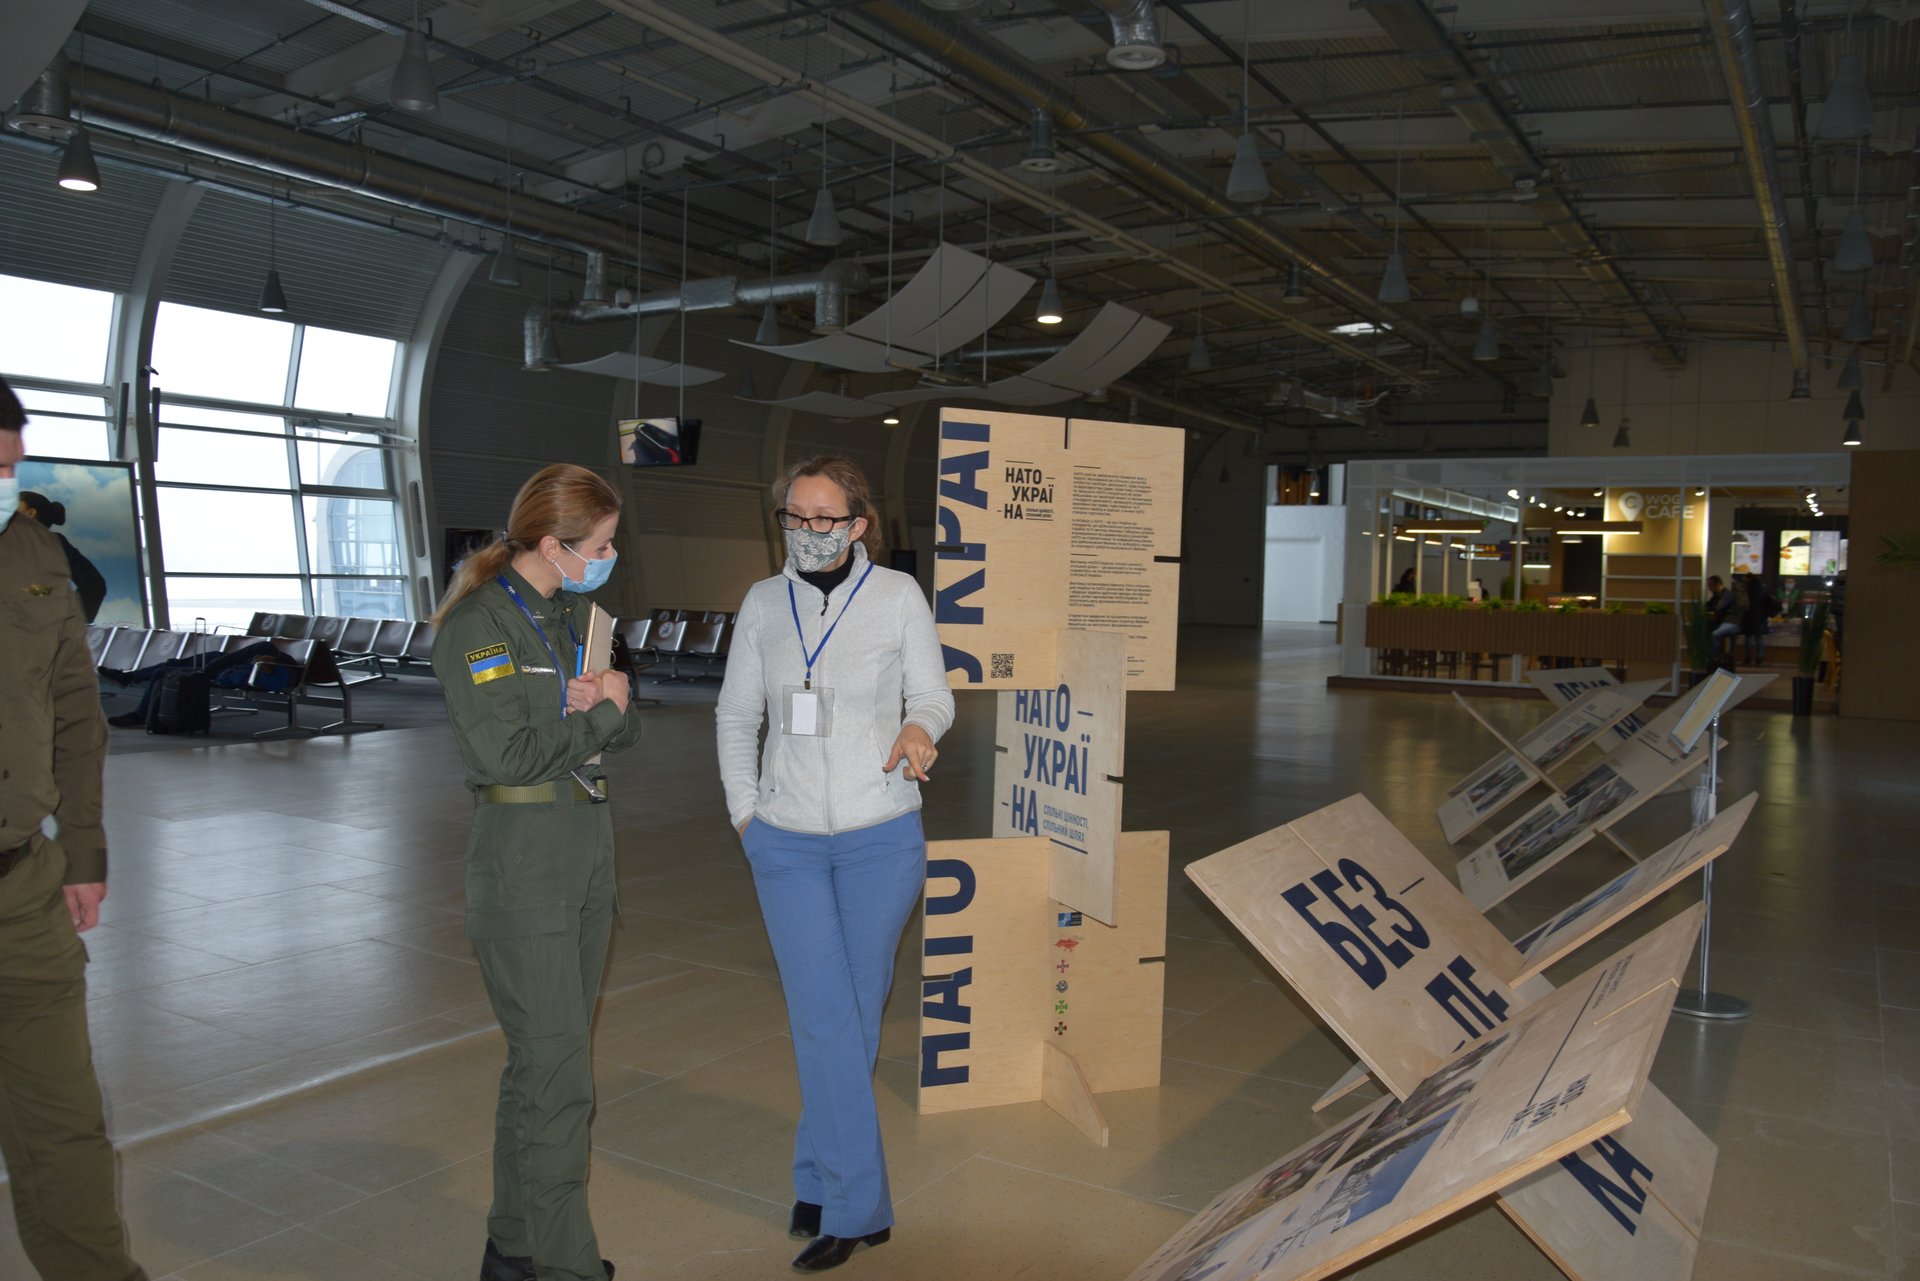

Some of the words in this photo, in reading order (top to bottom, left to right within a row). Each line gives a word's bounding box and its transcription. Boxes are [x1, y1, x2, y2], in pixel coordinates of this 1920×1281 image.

[1005, 467, 1042, 485] НАТО
[1012, 484, 1054, 503] УКРАЇ
[1004, 503, 1023, 520] НА
[1647, 505, 1695, 519] CAFE
[470, 646, 504, 662] УКРАЇНА
[1015, 683, 1071, 732] НАТО
[1024, 733, 1091, 796] УКРАЇ
[1012, 784, 1039, 836] НА
